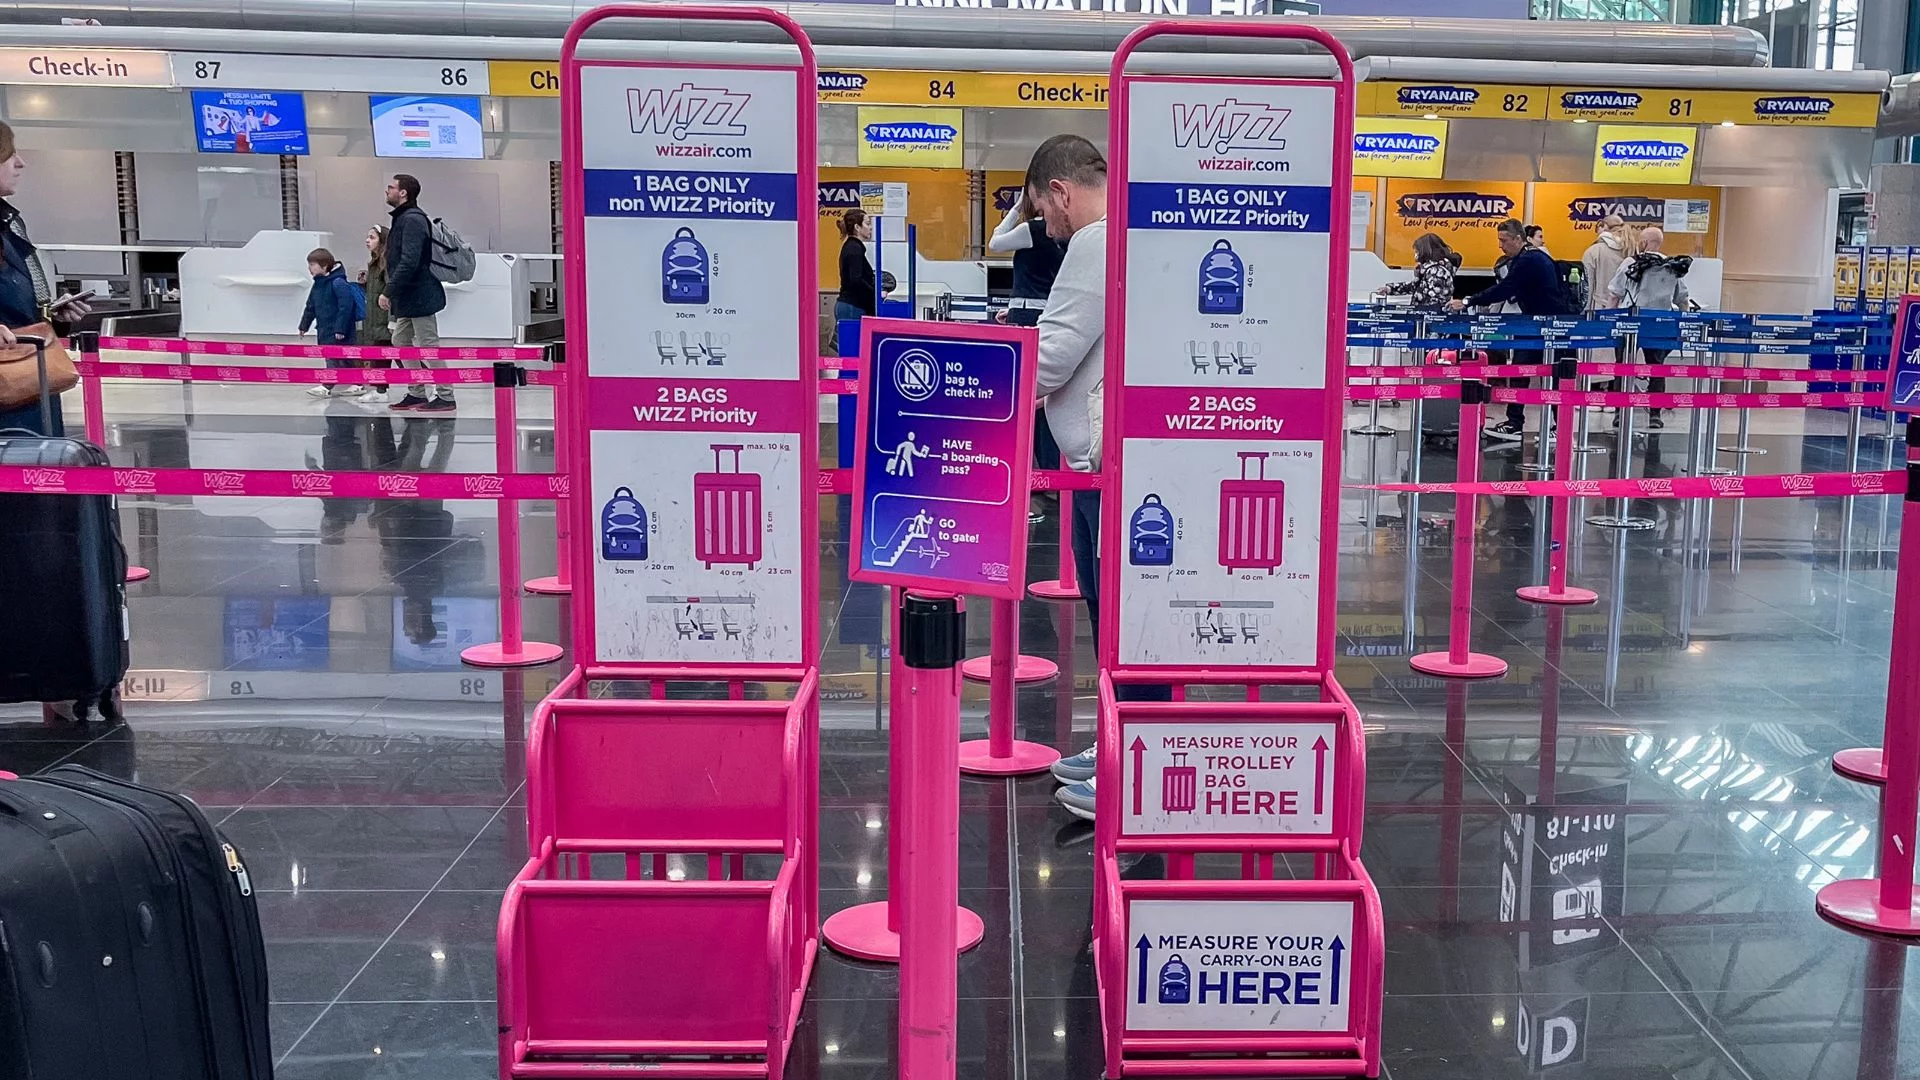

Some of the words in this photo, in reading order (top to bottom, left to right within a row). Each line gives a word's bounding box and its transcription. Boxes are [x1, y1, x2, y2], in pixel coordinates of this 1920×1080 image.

[28, 56, 128, 77] Check-in
[195, 61, 221, 79] 87
[441, 68, 468, 86] 86
[818, 76, 863, 88] ANAIR
[823, 91, 843, 100] great
[929, 80, 955, 99] 84
[1410, 90, 1475, 101] RYANAIR
[1503, 94, 1528, 112] 82
[1574, 95, 1638, 106] RYANAIR
[1767, 100, 1830, 111] RYANAIR
[1436, 104, 1455, 113] great
[1669, 98, 1692, 116] 81
[1598, 109, 1618, 118] great
[1789, 114, 1810, 123] great
[880, 127, 950, 139] RYANAIR
[908, 143, 930, 153] great
[1365, 137, 1435, 150] RYANAIR
[656, 143, 752, 158] wizzair.com
[1616, 144, 1684, 157] RYANAIR
[1392, 153, 1413, 162] great
[1199, 157, 1290, 172] wizzair.com
[1641, 160, 1662, 169] great
[633, 176, 641, 191] 1
[647, 176, 690, 192] BAG
[694, 177, 750, 193] ONLY
[1175, 189, 1182, 203] 1
[1188, 189, 1228, 205] BAG
[1233, 190, 1287, 206] ONLY
[609, 198, 644, 211] non
[649, 196, 702, 212] WIZZ
[708, 198, 775, 217] Priority
[1416, 198, 1508, 214] RYANAIR
[1588, 202, 1663, 217] RYANAI
[1151, 211, 1185, 224] non
[1190, 209, 1240, 225] WIZZ
[1245, 210, 1309, 229] Priority
[1404, 217, 1422, 226] Low
[1452, 218, 1480, 231] great
[1574, 220, 1592, 230] Low
[713, 253, 719, 265] cm
[712, 267, 719, 277] 40
[1248, 264, 1253, 275] cm
[1248, 278, 1253, 287] 40
[945, 362, 962, 372] NO
[945, 374, 965, 386] bag
[968, 376, 979, 385] to
[657, 387, 669, 402] 2
[673, 388, 727, 403] BAGS
[944, 388, 975, 398] check
[978, 389, 993, 399] in?
[1188, 396, 1200, 411] 2
[1205, 397, 1256, 412] BAGS
[633, 406, 686, 422] WIZZ
[691, 407, 757, 426] Priority
[1165, 415, 1215, 430] WIZZ
[1220, 415, 1284, 434] Priority
[780, 443, 790, 452] kg
[942, 439, 972, 450] HAVE
[951, 451, 999, 466] boarding
[1304, 450, 1313, 458] kg
[941, 465, 970, 475] pass?
[652, 512, 657, 522] cm
[768, 511, 773, 521] cm
[1288, 517, 1294, 527] cm
[767, 522, 773, 532] 55
[939, 519, 956, 528] GO
[1178, 517, 1183, 528] cm
[651, 524, 657, 534] 40
[1177, 529, 1183, 540] 40
[1288, 529, 1294, 538] 55
[939, 531, 949, 541] to
[952, 532, 979, 543] gate!
[1162, 736, 1243, 748] MEASURE
[1250, 737, 1297, 748] YOUR
[1205, 756, 1295, 770] TROLLEY
[1205, 774, 1246, 788] BAG
[1205, 791, 1298, 815] HERE
[1159, 935, 1258, 950] MEASURE
[1265, 936, 1324, 950] YOUR
[1200, 954, 1284, 966] CARRY-ON
[1288, 955, 1322, 967] BAG
[1198, 971, 1321, 1005] HERE
